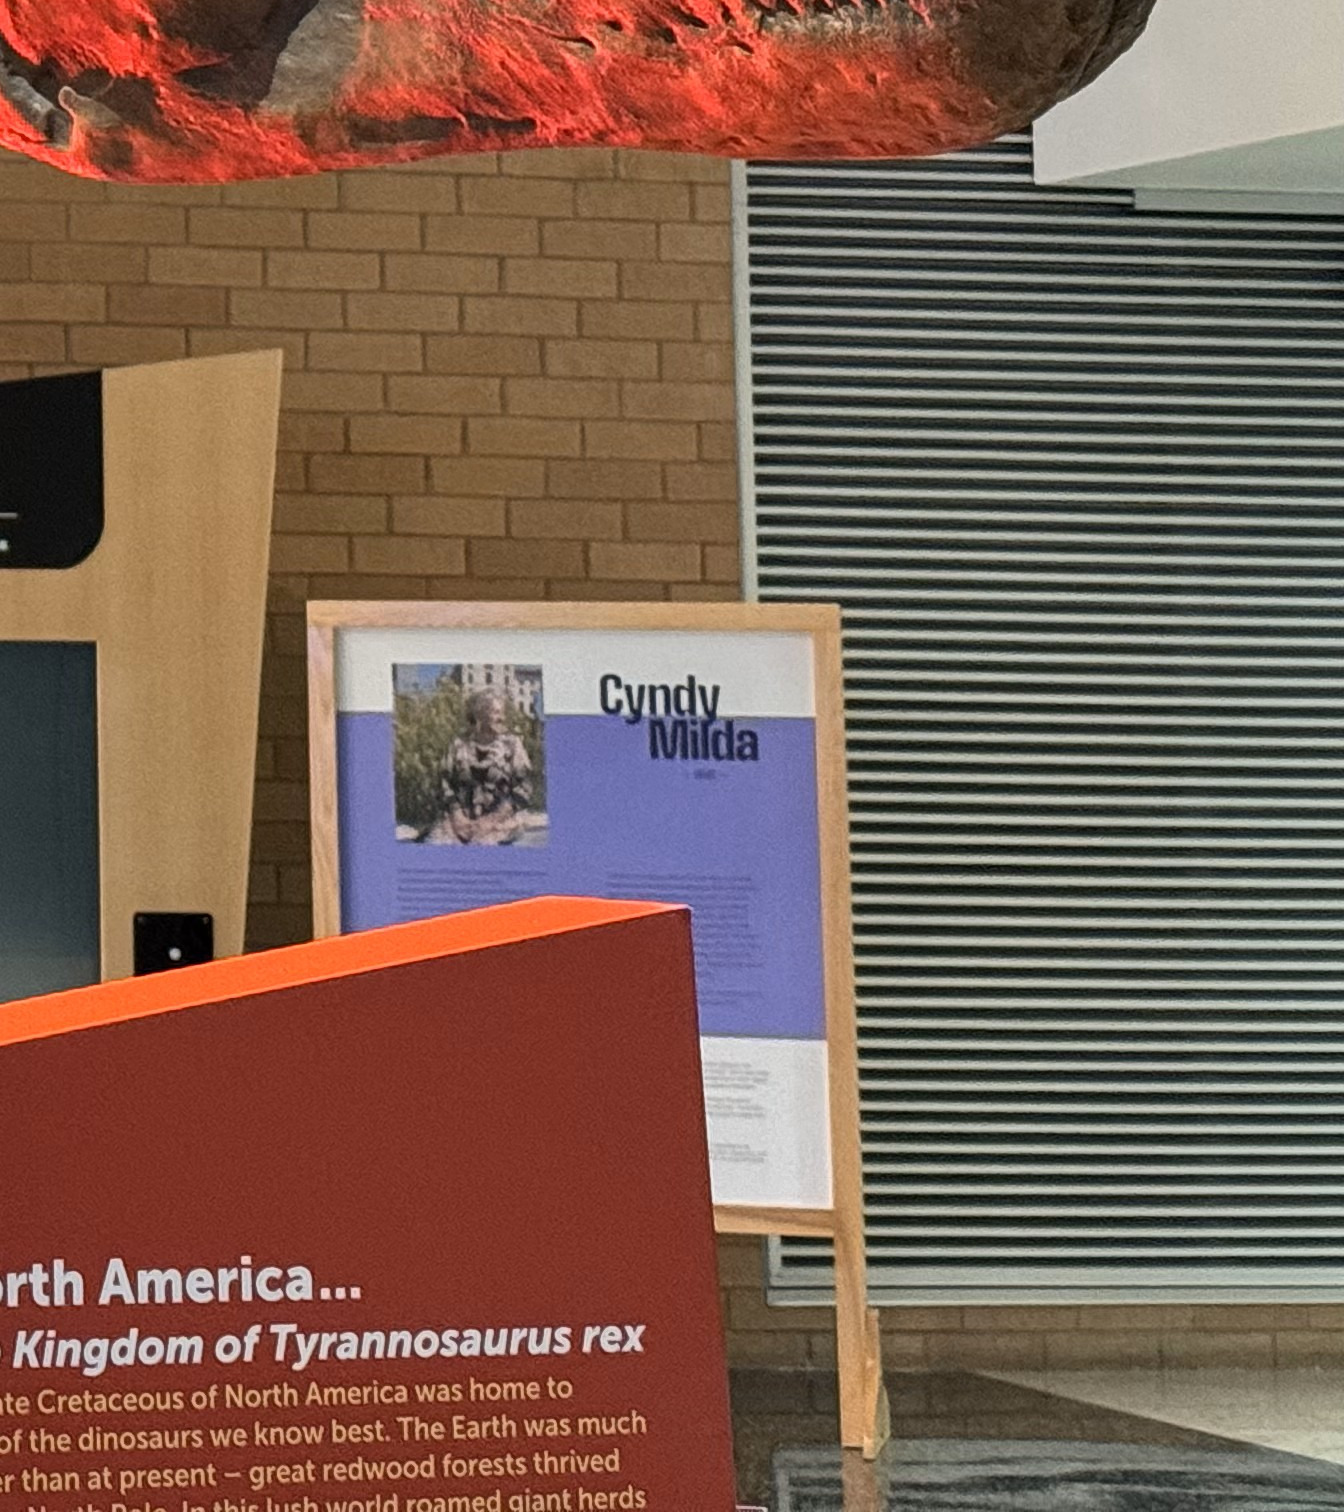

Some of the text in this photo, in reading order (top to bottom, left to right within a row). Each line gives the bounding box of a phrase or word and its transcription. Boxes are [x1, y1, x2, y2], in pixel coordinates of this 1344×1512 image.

[599, 673, 721, 725] Cyndy
[648, 718, 760, 761] Milda
[12, 1327, 204, 1377] Kingdom
[214, 1324, 263, 1364] of
[269, 1323, 573, 1372] Tyrannosaurus
[581, 1324, 647, 1354] rex
[37, 1389, 185, 1414] Cretaceous
[190, 1383, 218, 1410] of
[225, 1381, 299, 1409] North
[305, 1379, 408, 1406] America
[414, 1383, 463, 1403] was
[469, 1376, 541, 1402] home
[546, 1376, 573, 1399] to
[29, 1428, 72, 1453] the
[78, 1426, 204, 1452] dinosaurs
[209, 1428, 248, 1447] we
[254, 1420, 325, 1446] know
[331, 1418, 391, 1444] best.
[395, 1416, 446, 1441] The
[452, 1413, 517, 1440] Earth
[523, 1417, 572, 1437] was
[577, 1409, 647, 1436] much
[21, 1466, 80, 1493] than
[87, 1466, 113, 1491] at
[119, 1463, 217, 1496] present
[249, 1459, 316, 1491] great
[323, 1453, 436, 1482] redwood
[442, 1452, 528, 1478] forests
[532, 1447, 620, 1475] thrived
[406, 1489, 502, 1512] roamed
[508, 1487, 572, 1512] giant
[578, 1484, 647, 1512] herds
